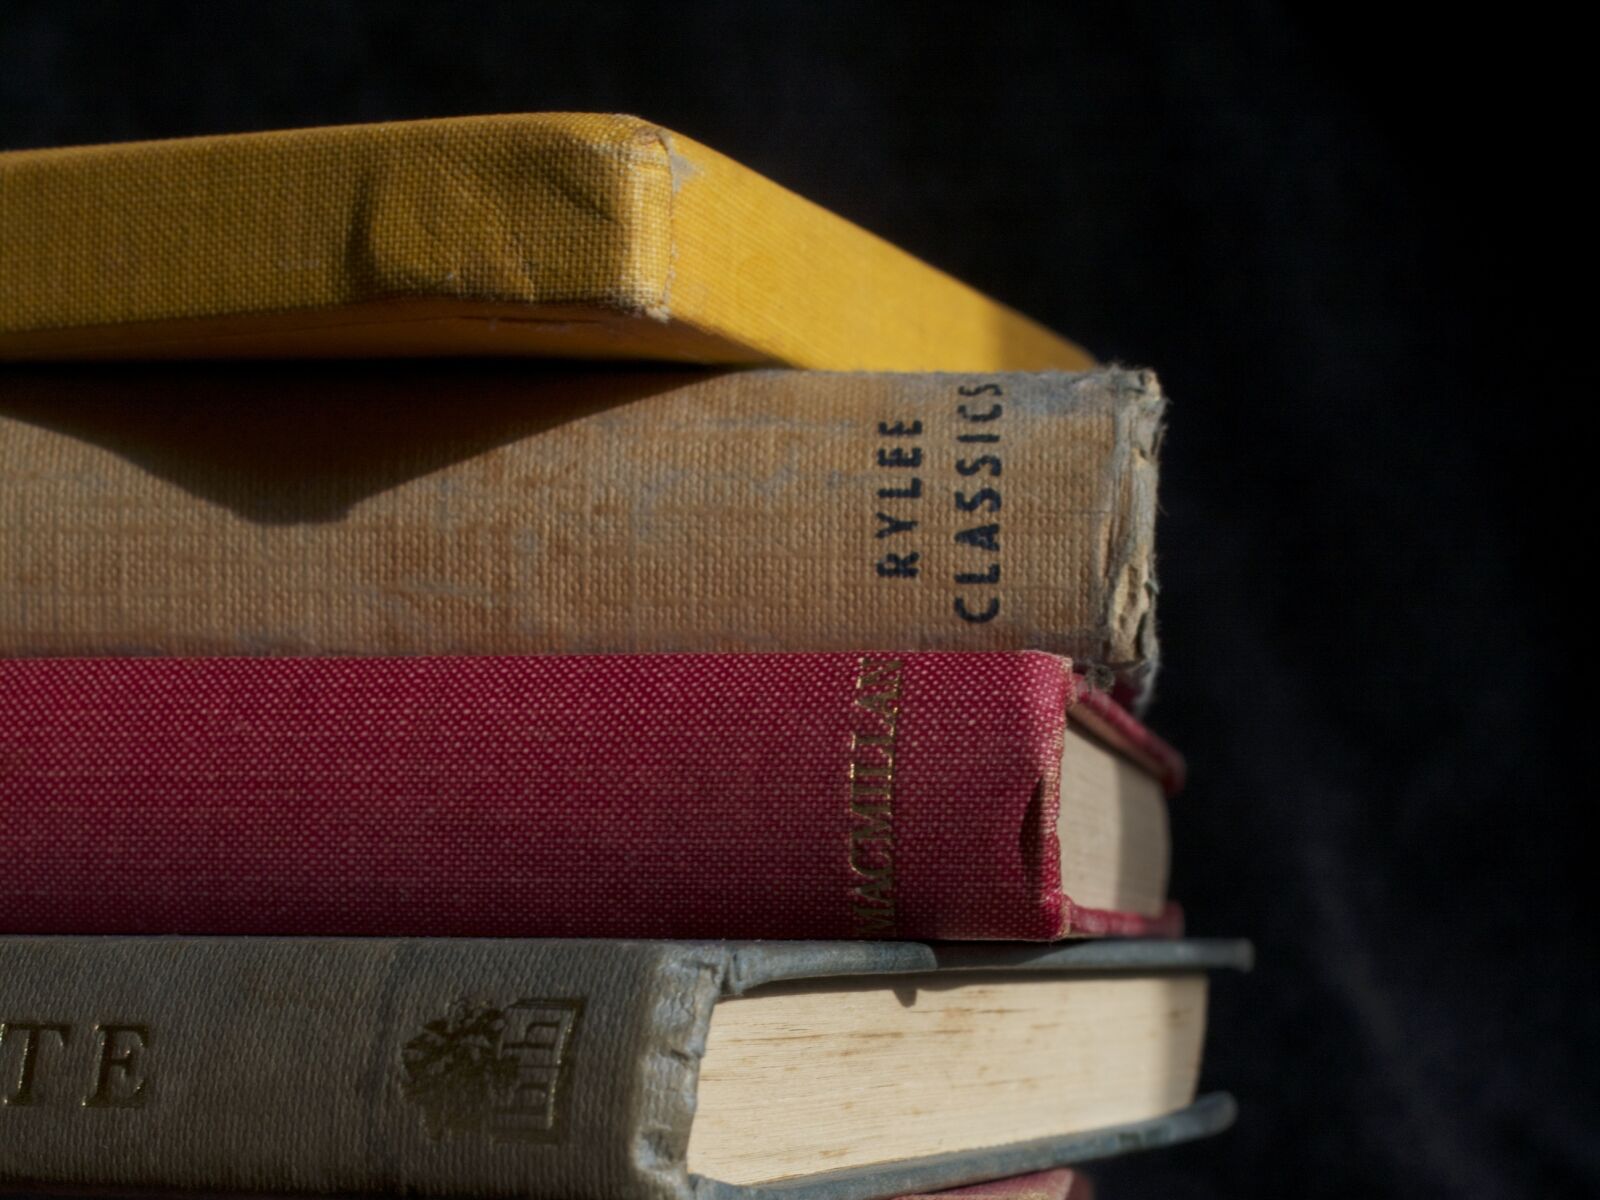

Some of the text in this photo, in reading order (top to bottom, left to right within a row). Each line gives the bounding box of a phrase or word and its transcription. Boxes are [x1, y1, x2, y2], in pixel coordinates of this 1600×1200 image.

[876, 420, 921, 578] RYLEE
[954, 384, 1002, 624] CLASSICS
[848, 656, 903, 936] MACMILLAN
